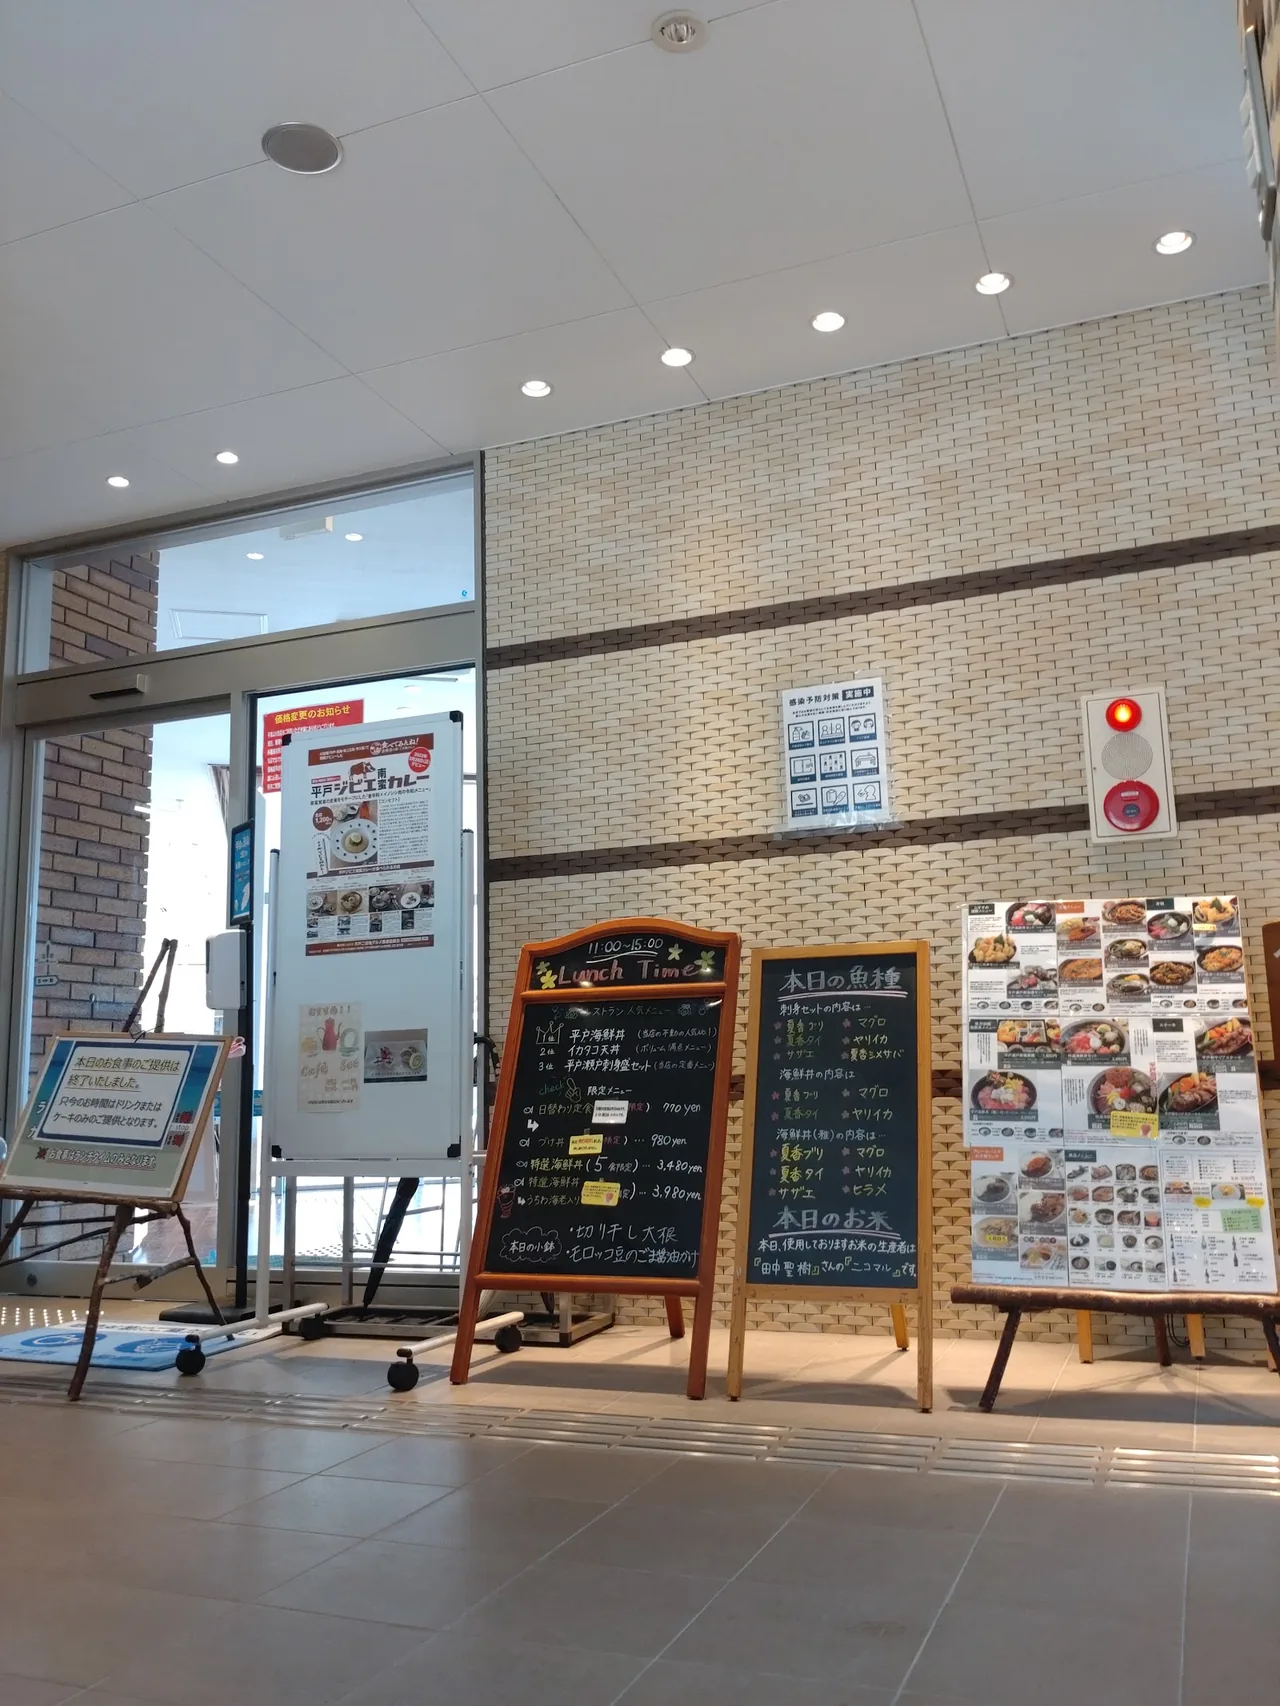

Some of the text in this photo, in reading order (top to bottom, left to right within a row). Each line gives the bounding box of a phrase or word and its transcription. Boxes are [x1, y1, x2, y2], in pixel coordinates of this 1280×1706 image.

[789, 693, 839, 706] 感染予防対策
[845, 688, 871, 699] 実施中
[275, 705, 350, 724] 価格変更のお知らせ
[558, 959, 700, 985] Lunch Time
[778, 964, 902, 993] 本日の魚種
[627, 1005, 672, 1016] 人気メニュー
[857, 1015, 887, 1029] マグロ
[569, 1028, 626, 1043] 平戸海鮮丼
[853, 1034, 888, 1045] ヤリイカ
[539, 1047, 555, 1057] 2位
[567, 1044, 621, 1057] イカタコ天丼
[786, 1049, 815, 1060] サザエ
[75, 1056, 181, 1072] 本日のお食事のご提供は
[538, 1062, 554, 1072] 3位
[778, 1067, 856, 1081] 海鮮丼の内容は
[67, 1074, 140, 1090] 終了いたしました。
[587, 1085, 633, 1097] 限定メニュー
[858, 1084, 889, 1099] マグロ
[58, 1096, 163, 1112] 只今のお時間はドリンクまたは
[538, 1102, 594, 1115] 日替わり定食
[52, 1113, 159, 1129] ケーキのみのご提供となります。
[852, 1107, 893, 1121] ヤリイカ
[538, 1136, 565, 1147] づけ丼
[780, 1143, 885, 1162] 夏香ブリ マグロ
[855, 1165, 892, 1179] ヤリイカ
[778, 1182, 888, 1200] サザエ ヒラメ
[526, 1194, 580, 1206] うちわ海老入り
[772, 1205, 893, 1231] 本日のお米
[508, 1239, 556, 1254] 本日の小鉢
